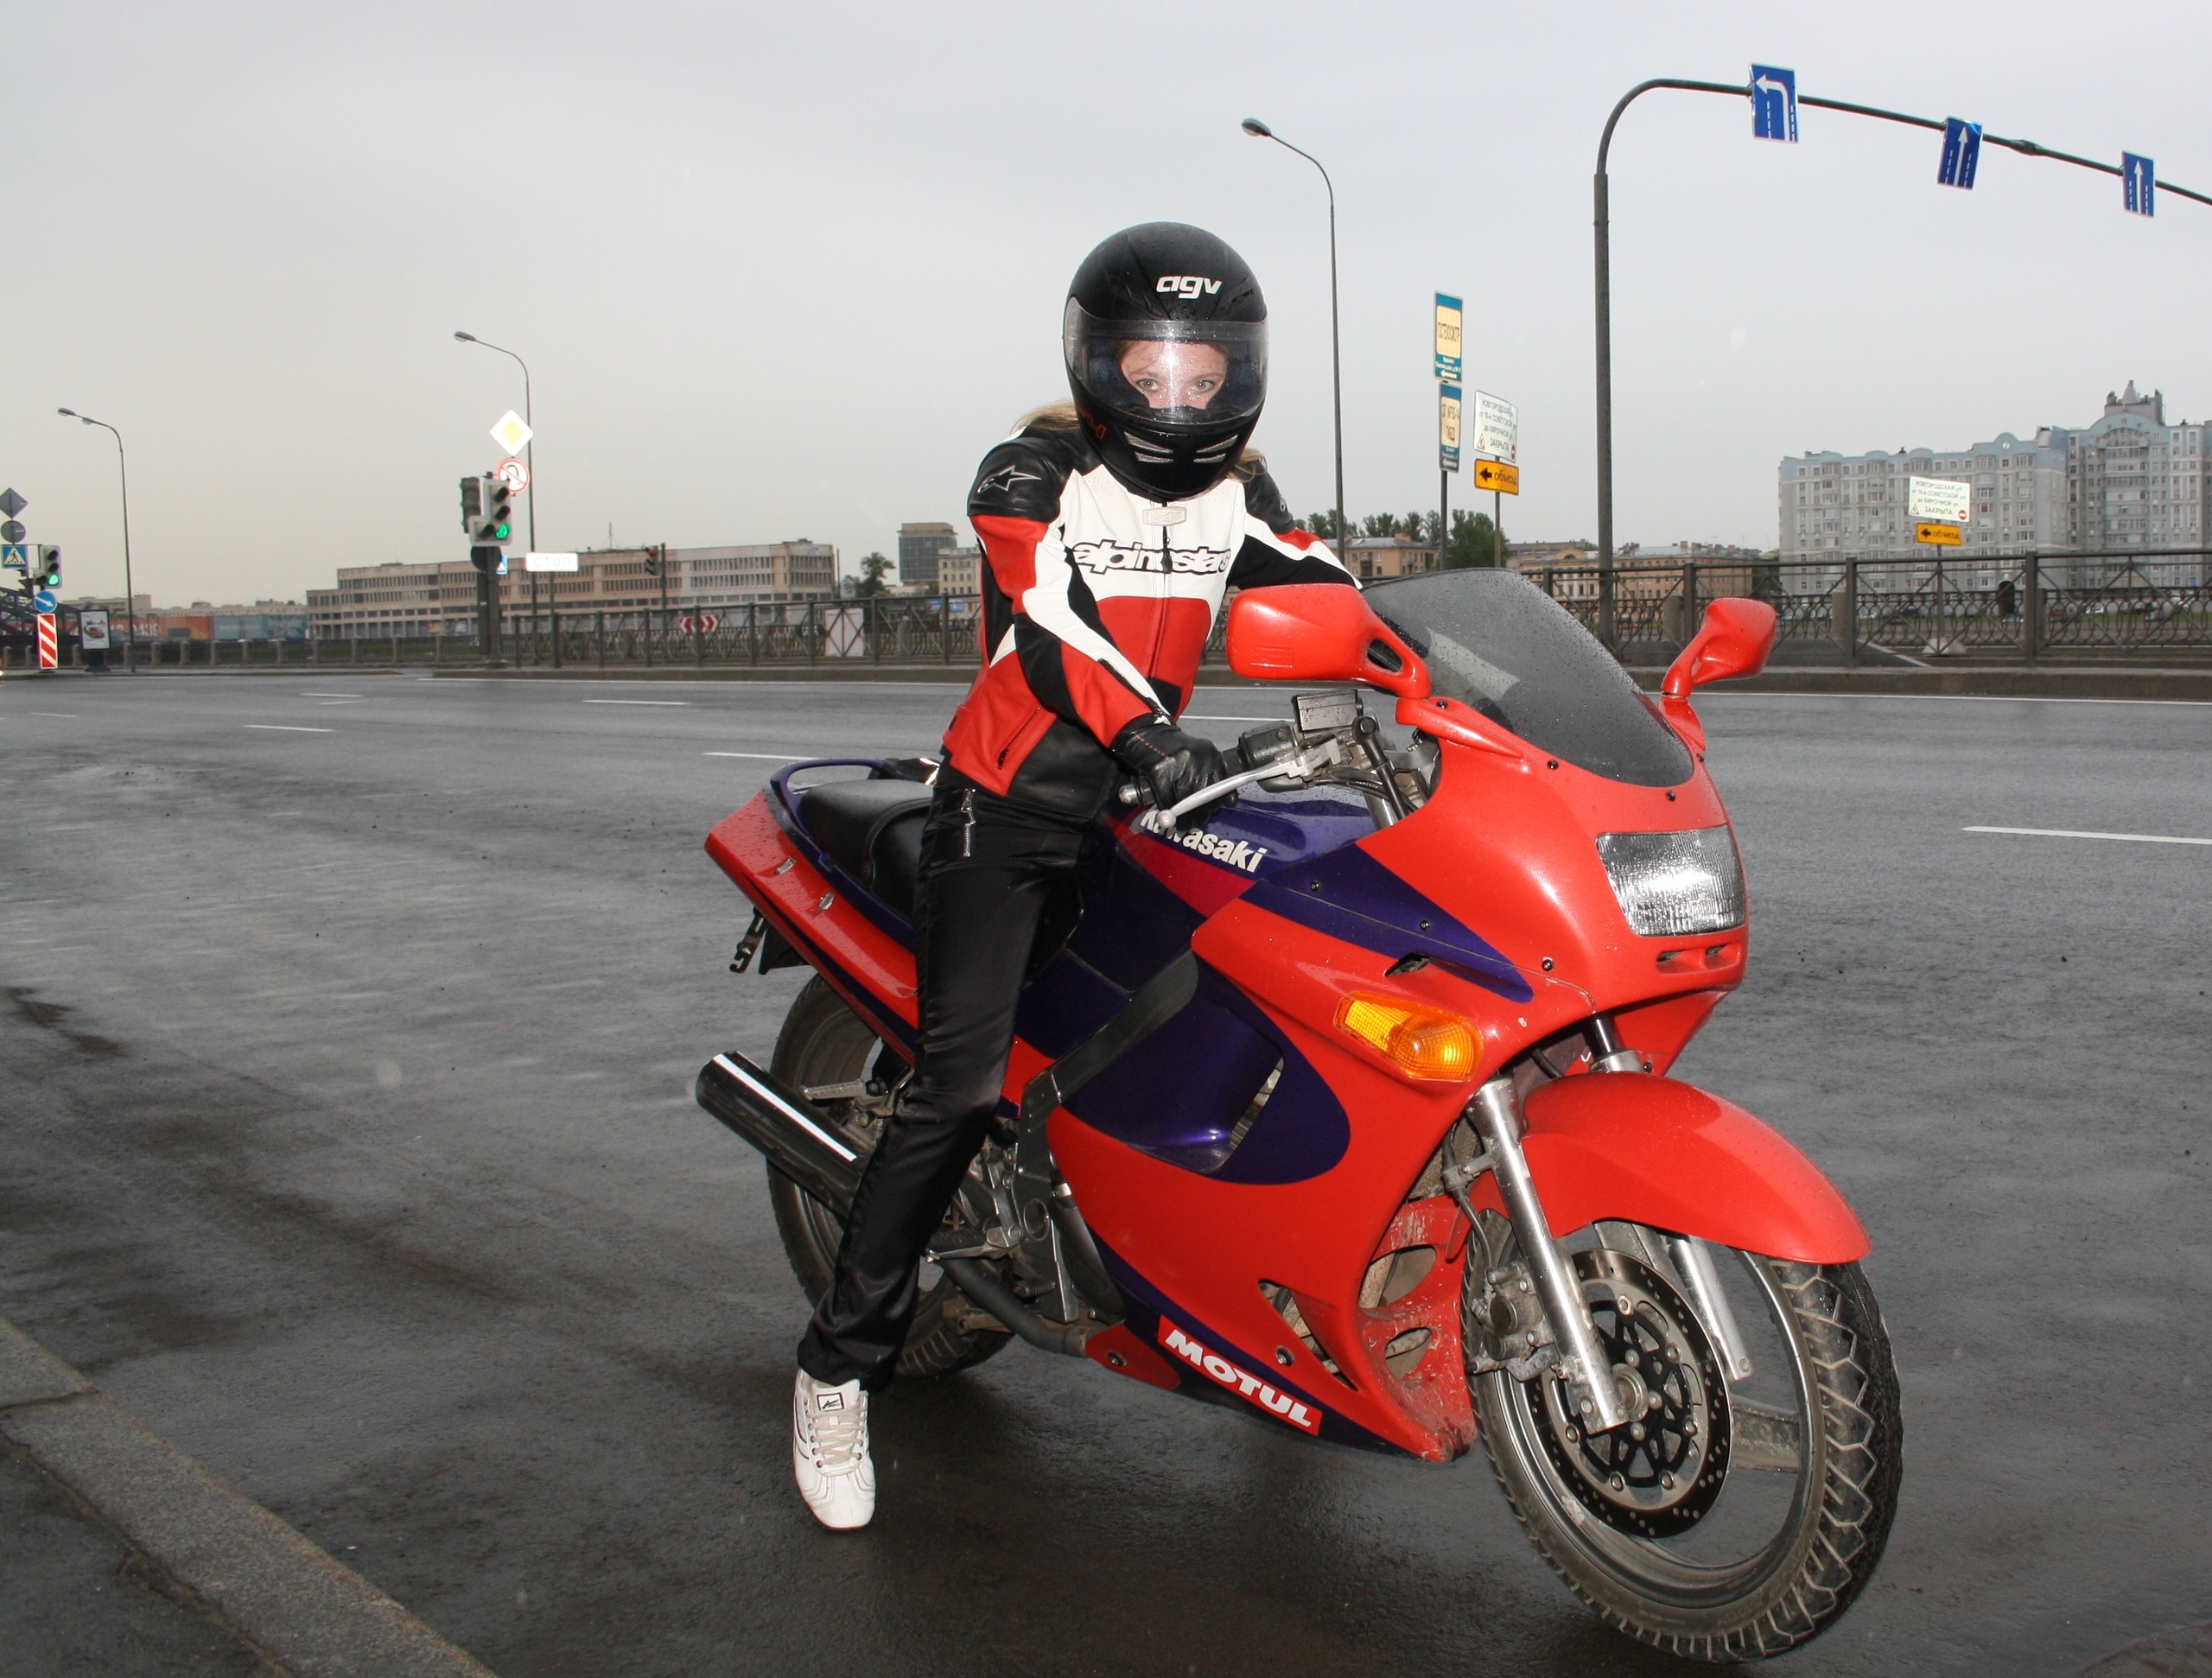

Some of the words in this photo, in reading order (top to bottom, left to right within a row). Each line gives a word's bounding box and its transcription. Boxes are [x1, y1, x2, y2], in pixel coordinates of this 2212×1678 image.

[1156, 276, 1223, 299] agv
[1924, 505, 1953, 515] ЗАКРЫТА
[534, 556, 570, 567] СТОП
[1072, 539, 1231, 575] alpinstars
[1140, 805, 1268, 874] Kasaki
[1165, 1329, 1313, 1427] MOTUL
